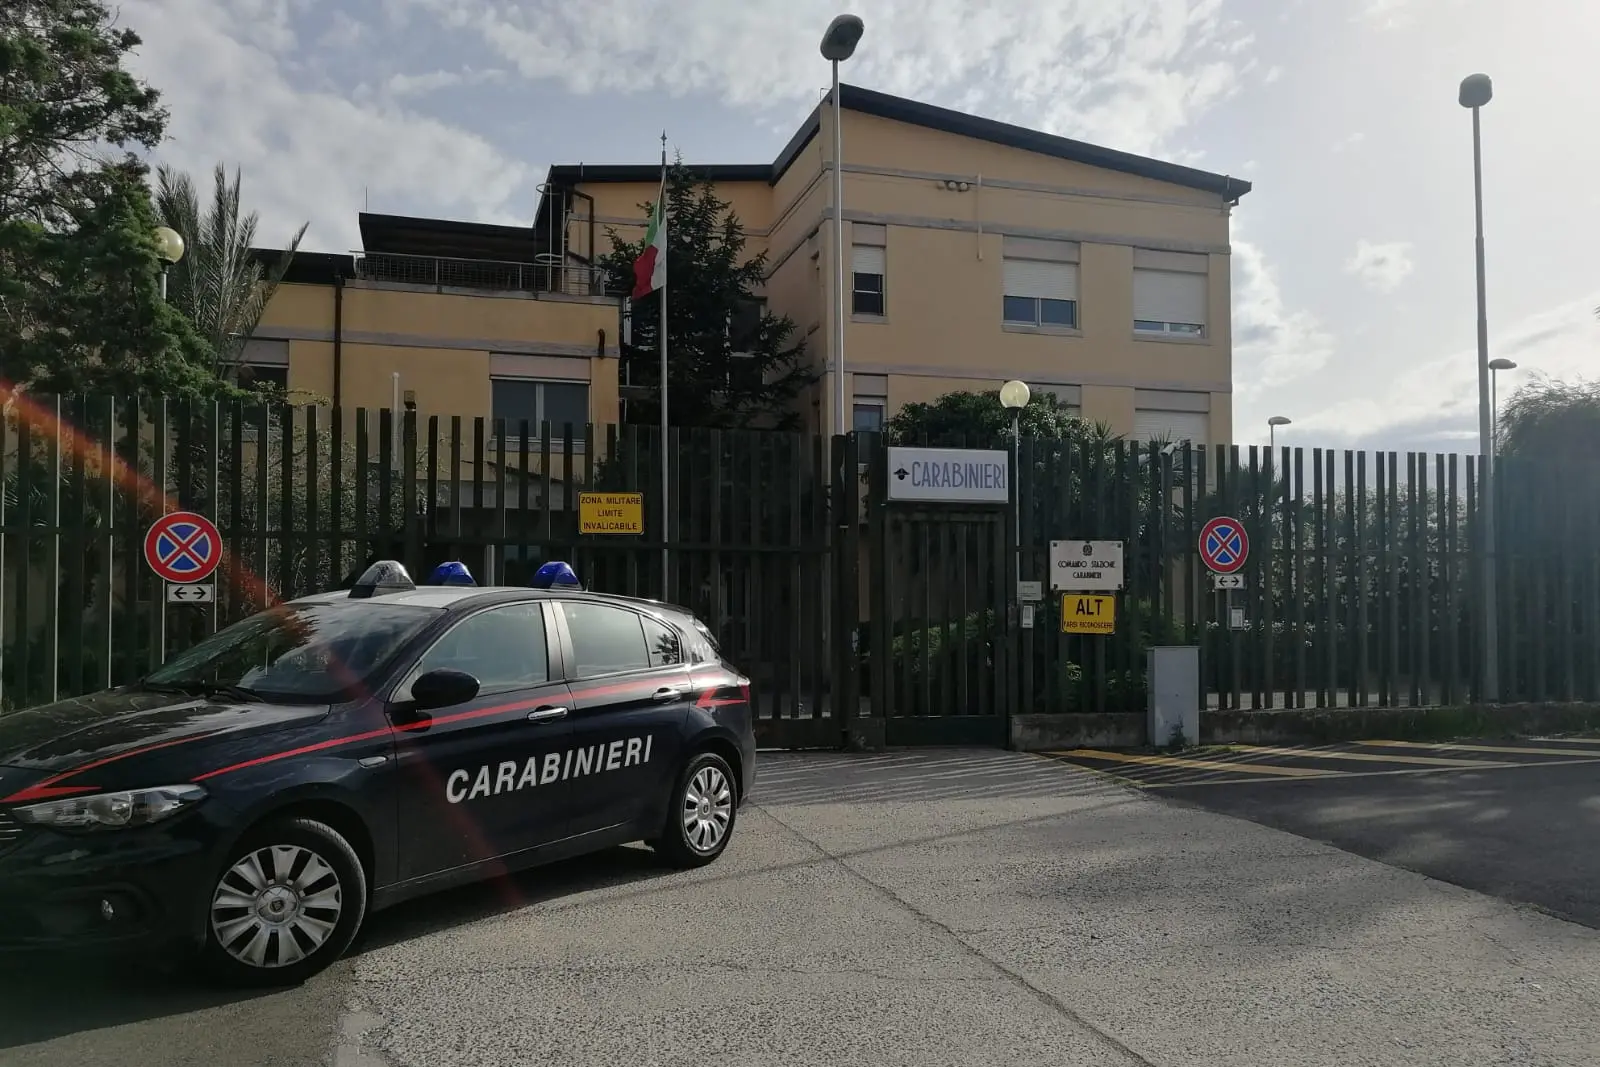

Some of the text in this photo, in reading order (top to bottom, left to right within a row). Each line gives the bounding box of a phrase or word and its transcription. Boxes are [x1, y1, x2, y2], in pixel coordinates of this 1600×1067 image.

[912, 461, 1006, 489] CARABINIERI
[581, 496, 641, 505] ZONA MILITARE
[597, 509, 624, 517] LIMITE
[583, 522, 638, 530] INVALICABILE
[1057, 560, 1116, 568] COMANDO STAZIONE
[1076, 598, 1104, 616] ALT
[446, 734, 653, 804] CARABINIERI
